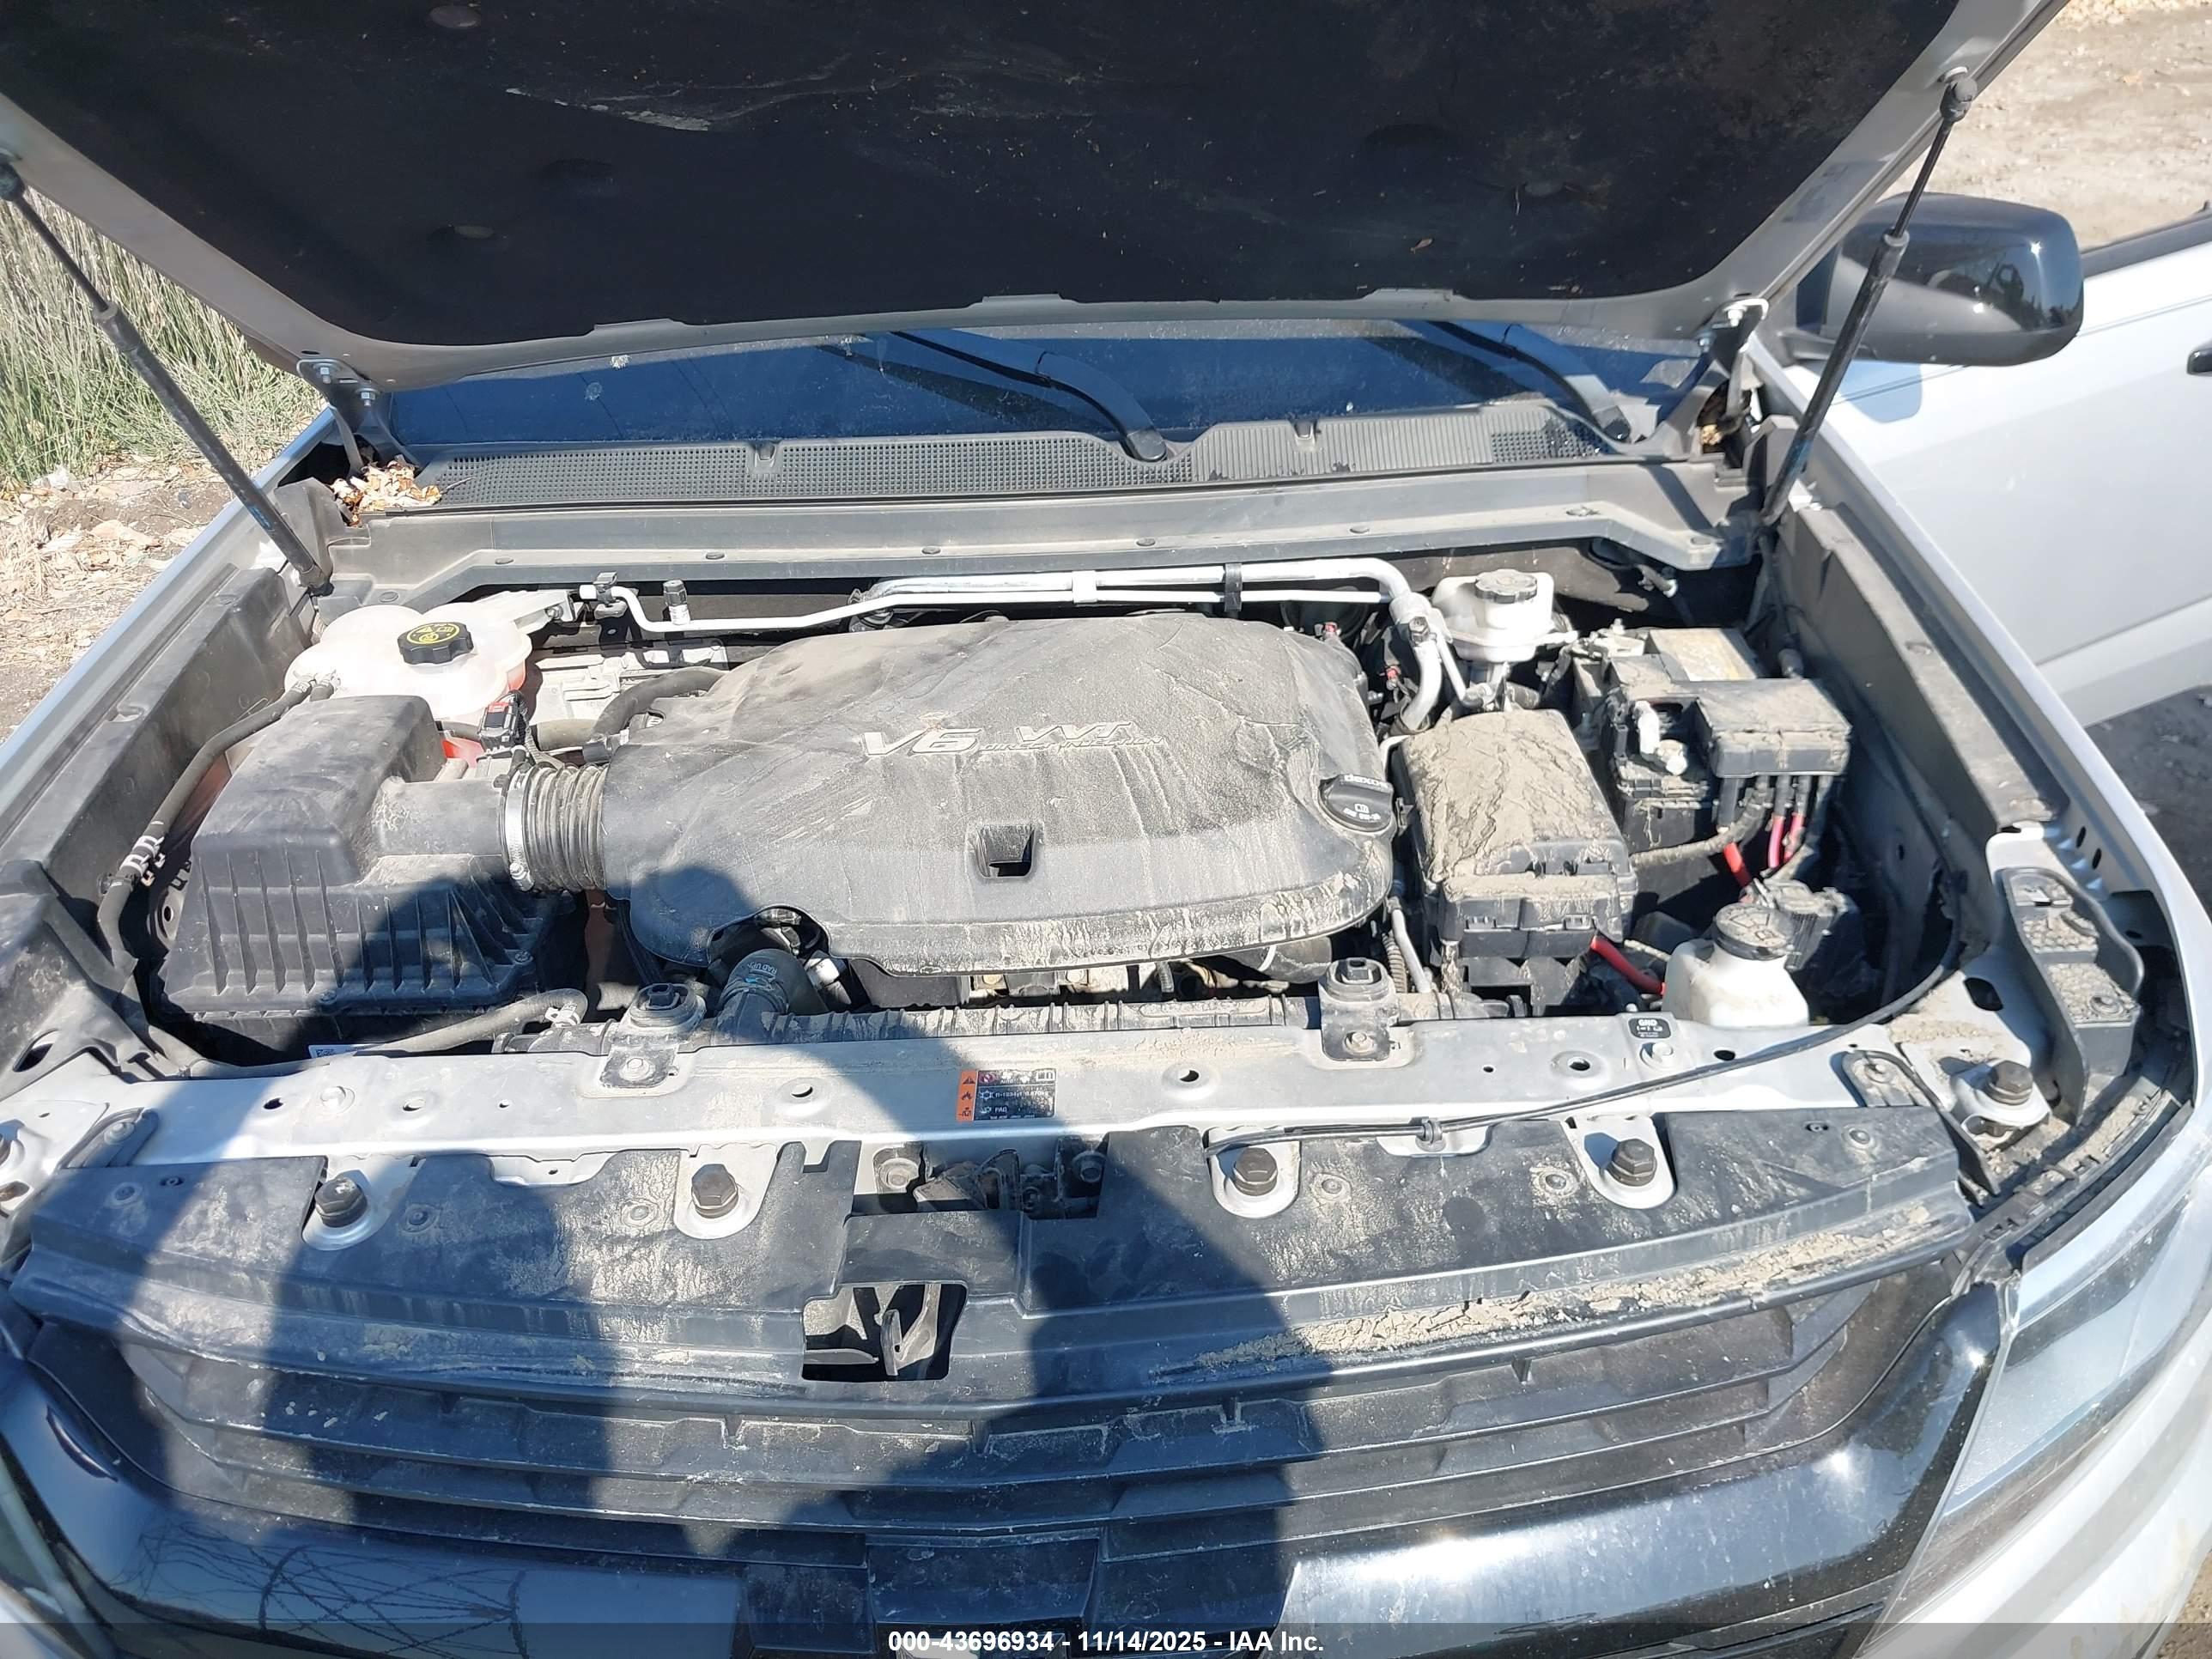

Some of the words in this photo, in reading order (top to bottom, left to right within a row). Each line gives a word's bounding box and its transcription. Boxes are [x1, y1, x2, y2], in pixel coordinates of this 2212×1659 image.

[863, 727, 982, 756] V6
[1017, 722, 1133, 742] VVT
[983, 742, 1055, 751] DIRECT
[1060, 736, 1168, 750] INJECTION
[762, 964, 777, 974] RAD
